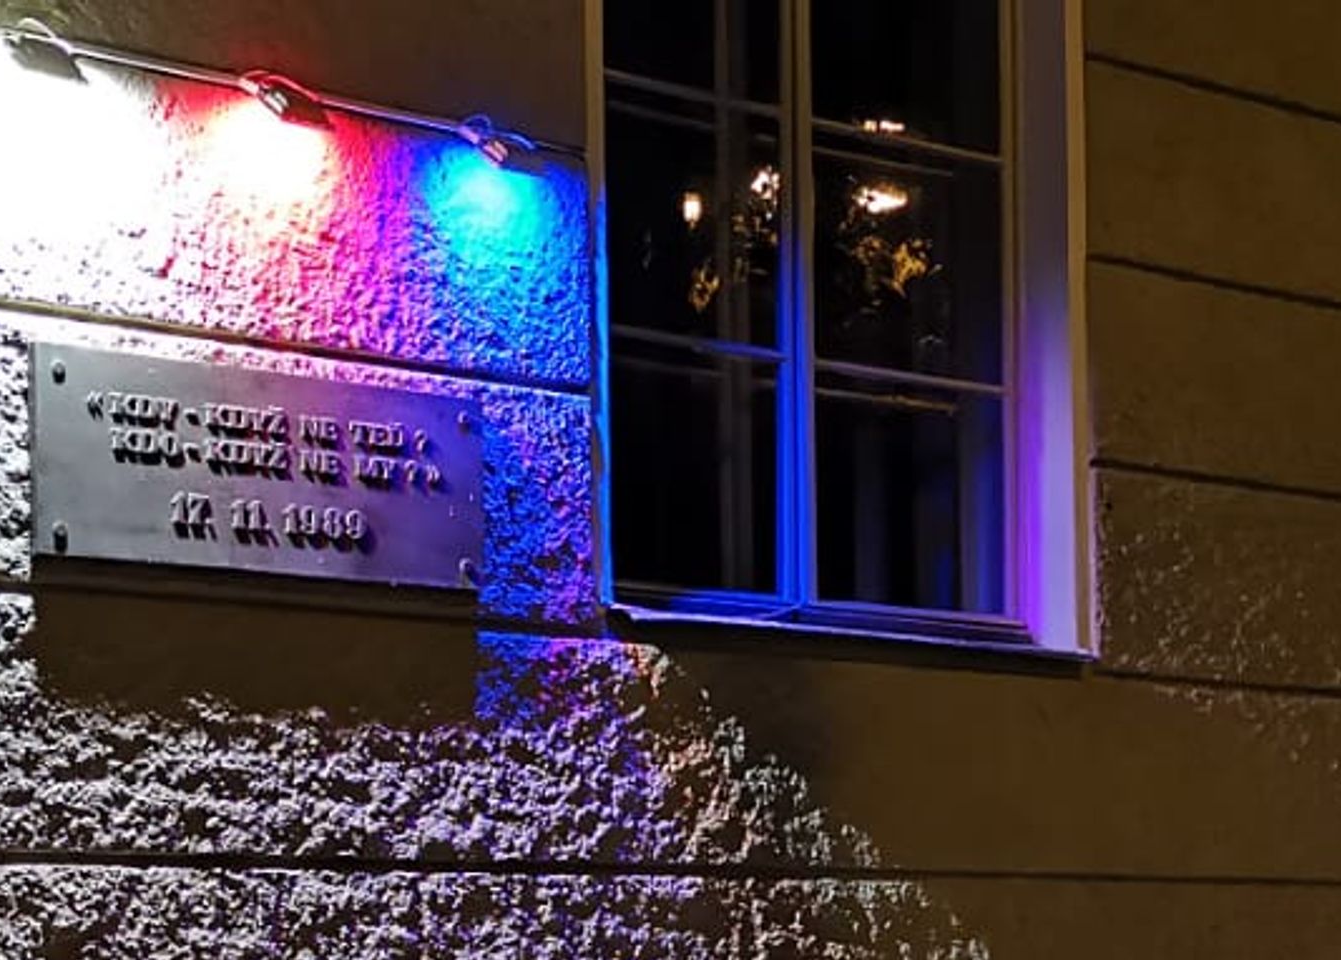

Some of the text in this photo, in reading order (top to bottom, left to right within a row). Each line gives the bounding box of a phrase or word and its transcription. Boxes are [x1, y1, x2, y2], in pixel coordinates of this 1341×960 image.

[299, 415, 339, 440] NE
[299, 449, 340, 475] NE
[170, 490, 215, 524] 17.
[282, 503, 366, 540] 1989
